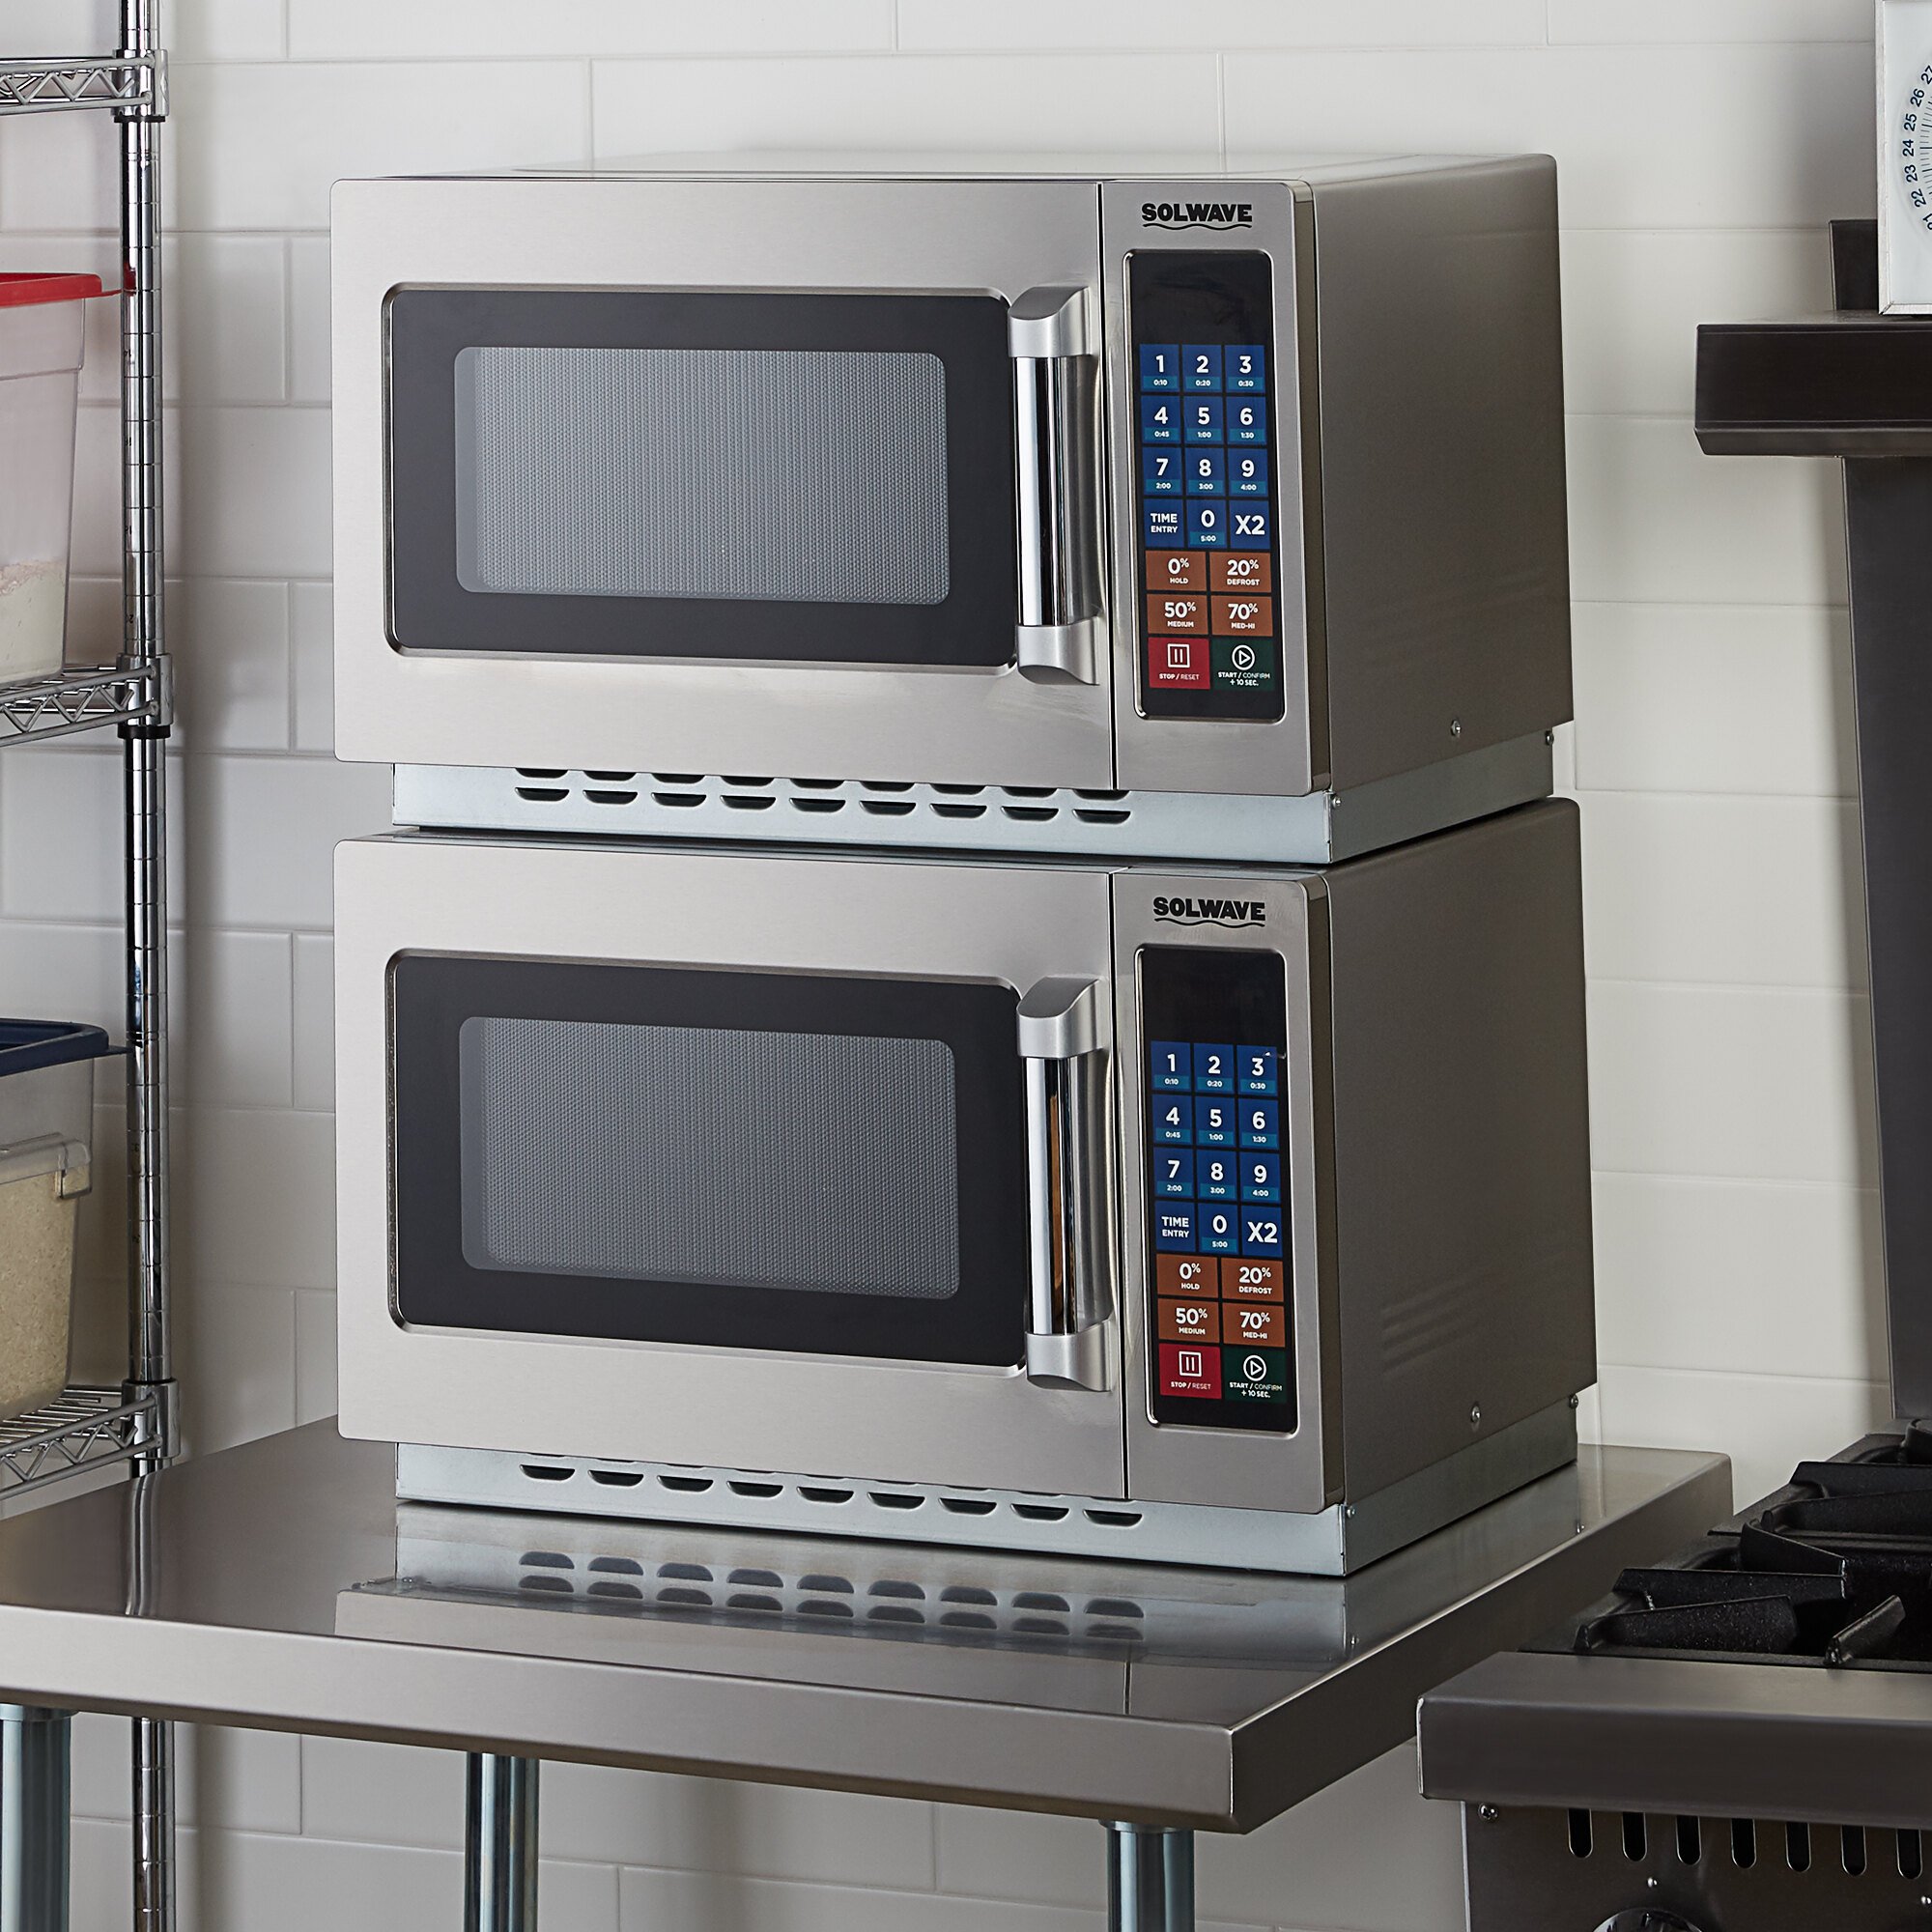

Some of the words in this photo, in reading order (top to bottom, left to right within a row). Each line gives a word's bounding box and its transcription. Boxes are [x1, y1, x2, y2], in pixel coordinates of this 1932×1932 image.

[1921, 65, 1932, 84] 27
[1910, 89, 1924, 107] 26
[1904, 114, 1917, 131] 25
[1903, 139, 1914, 156] 24
[1904, 165, 1918, 183] 23
[1911, 188, 1926, 207] 22
[1142, 203, 1252, 221] SOLWAVE
[1155, 355, 1164, 373] 1
[1196, 355, 1208, 373] 2
[1239, 355, 1251, 374] 3
[1154, 407, 1168, 424] 4
[1198, 408, 1209, 425] 5
[1240, 408, 1253, 425] 6
[1156, 458, 1169, 475] 7
[1199, 459, 1211, 476] 8
[1241, 460, 1255, 477] 9
[1151, 513, 1178, 523] TIME
[1201, 510, 1215, 527] 0
[1236, 515, 1264, 535] X2
[1168, 557, 1189, 575] 0%
[1227, 559, 1259, 576] 20%
[1165, 602, 1196, 618] 50%
[1228, 604, 1258, 619] 70%
[1153, 897, 1265, 921] SOLWAVE
[1167, 1054, 1176, 1071] 1
[1208, 1056, 1220, 1074] 2
[1252, 1058, 1264, 1076] 3
[1166, 1107, 1179, 1124] 4
[1209, 1109, 1222, 1127] 5
[1253, 1112, 1265, 1129] 6
[1168, 1160, 1179, 1179] 7
[1211, 1163, 1223, 1180] 8
[1254, 1165, 1266, 1183] 9
[1161, 1216, 1189, 1227] TIME
[1212, 1215, 1227, 1234] 0
[1248, 1222, 1277, 1243] X2
[1179, 1263, 1201, 1280] 0%
[1239, 1266, 1271, 1284] 20%
[1176, 1307, 1208, 1324] 50%
[1239, 1312, 1270, 1329] 70%
